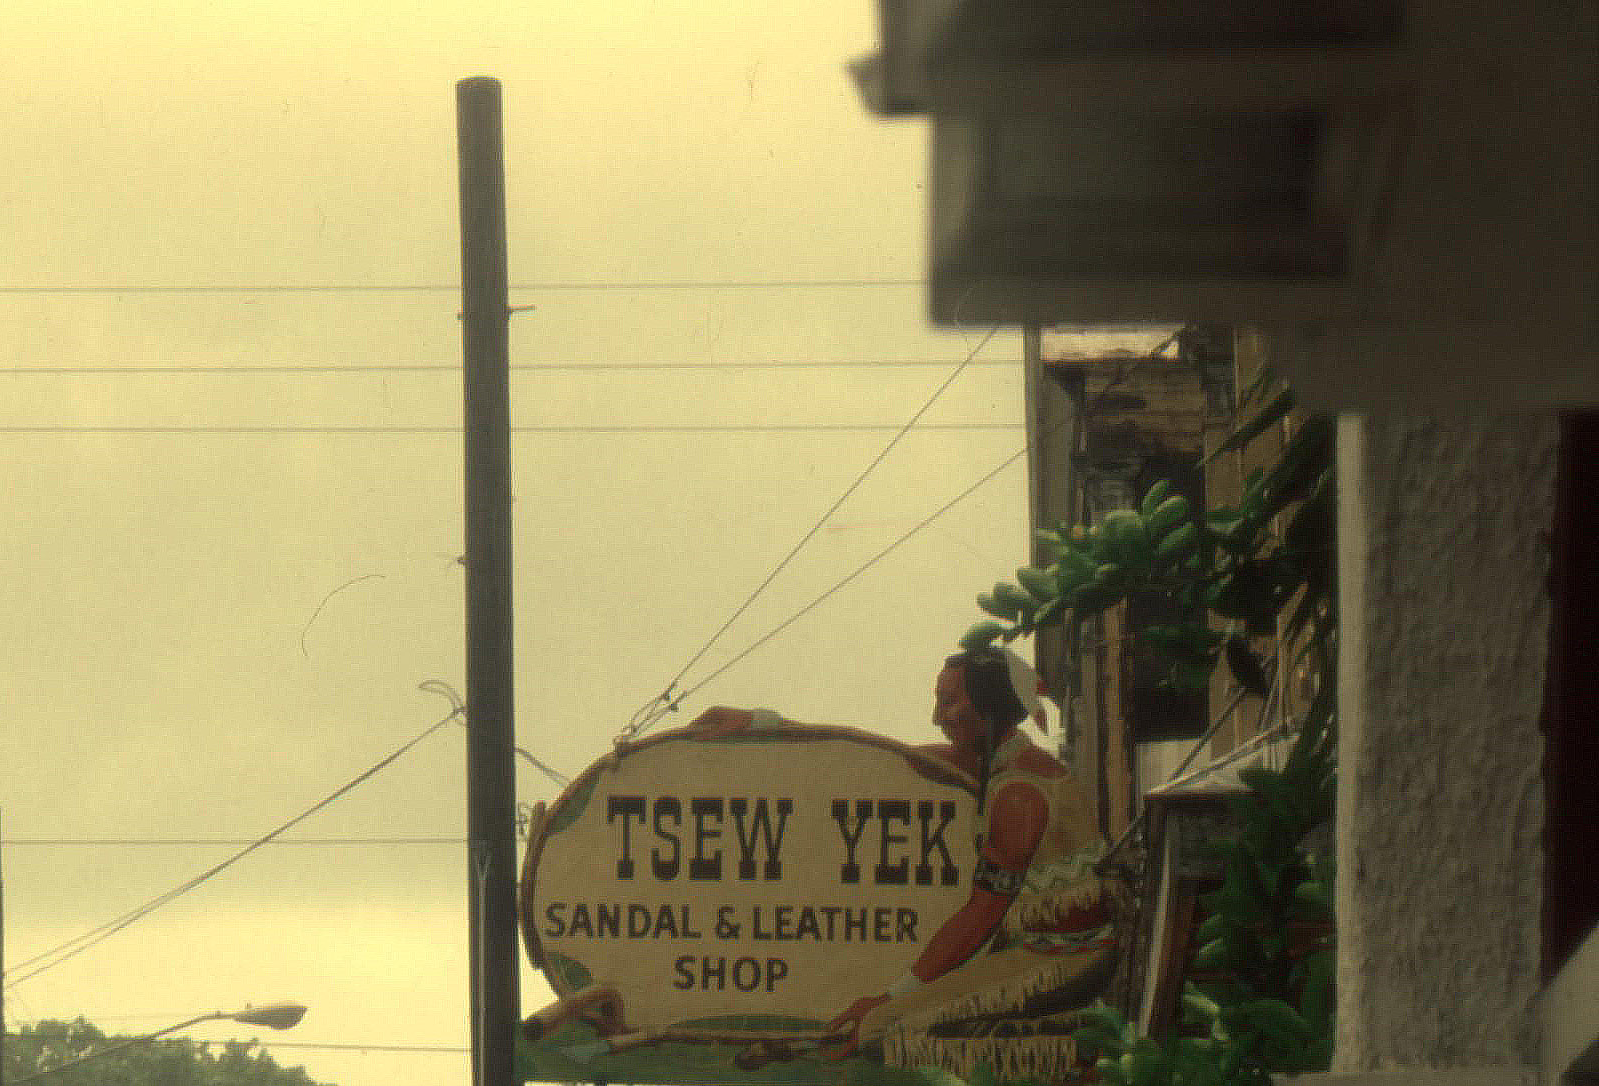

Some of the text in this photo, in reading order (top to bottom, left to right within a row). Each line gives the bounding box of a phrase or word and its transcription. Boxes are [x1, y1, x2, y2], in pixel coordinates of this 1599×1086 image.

[607, 795, 959, 885] TSEW YEK
[545, 902, 919, 942] SANDAL & LEATHER
[674, 956, 789, 992] SHOP
